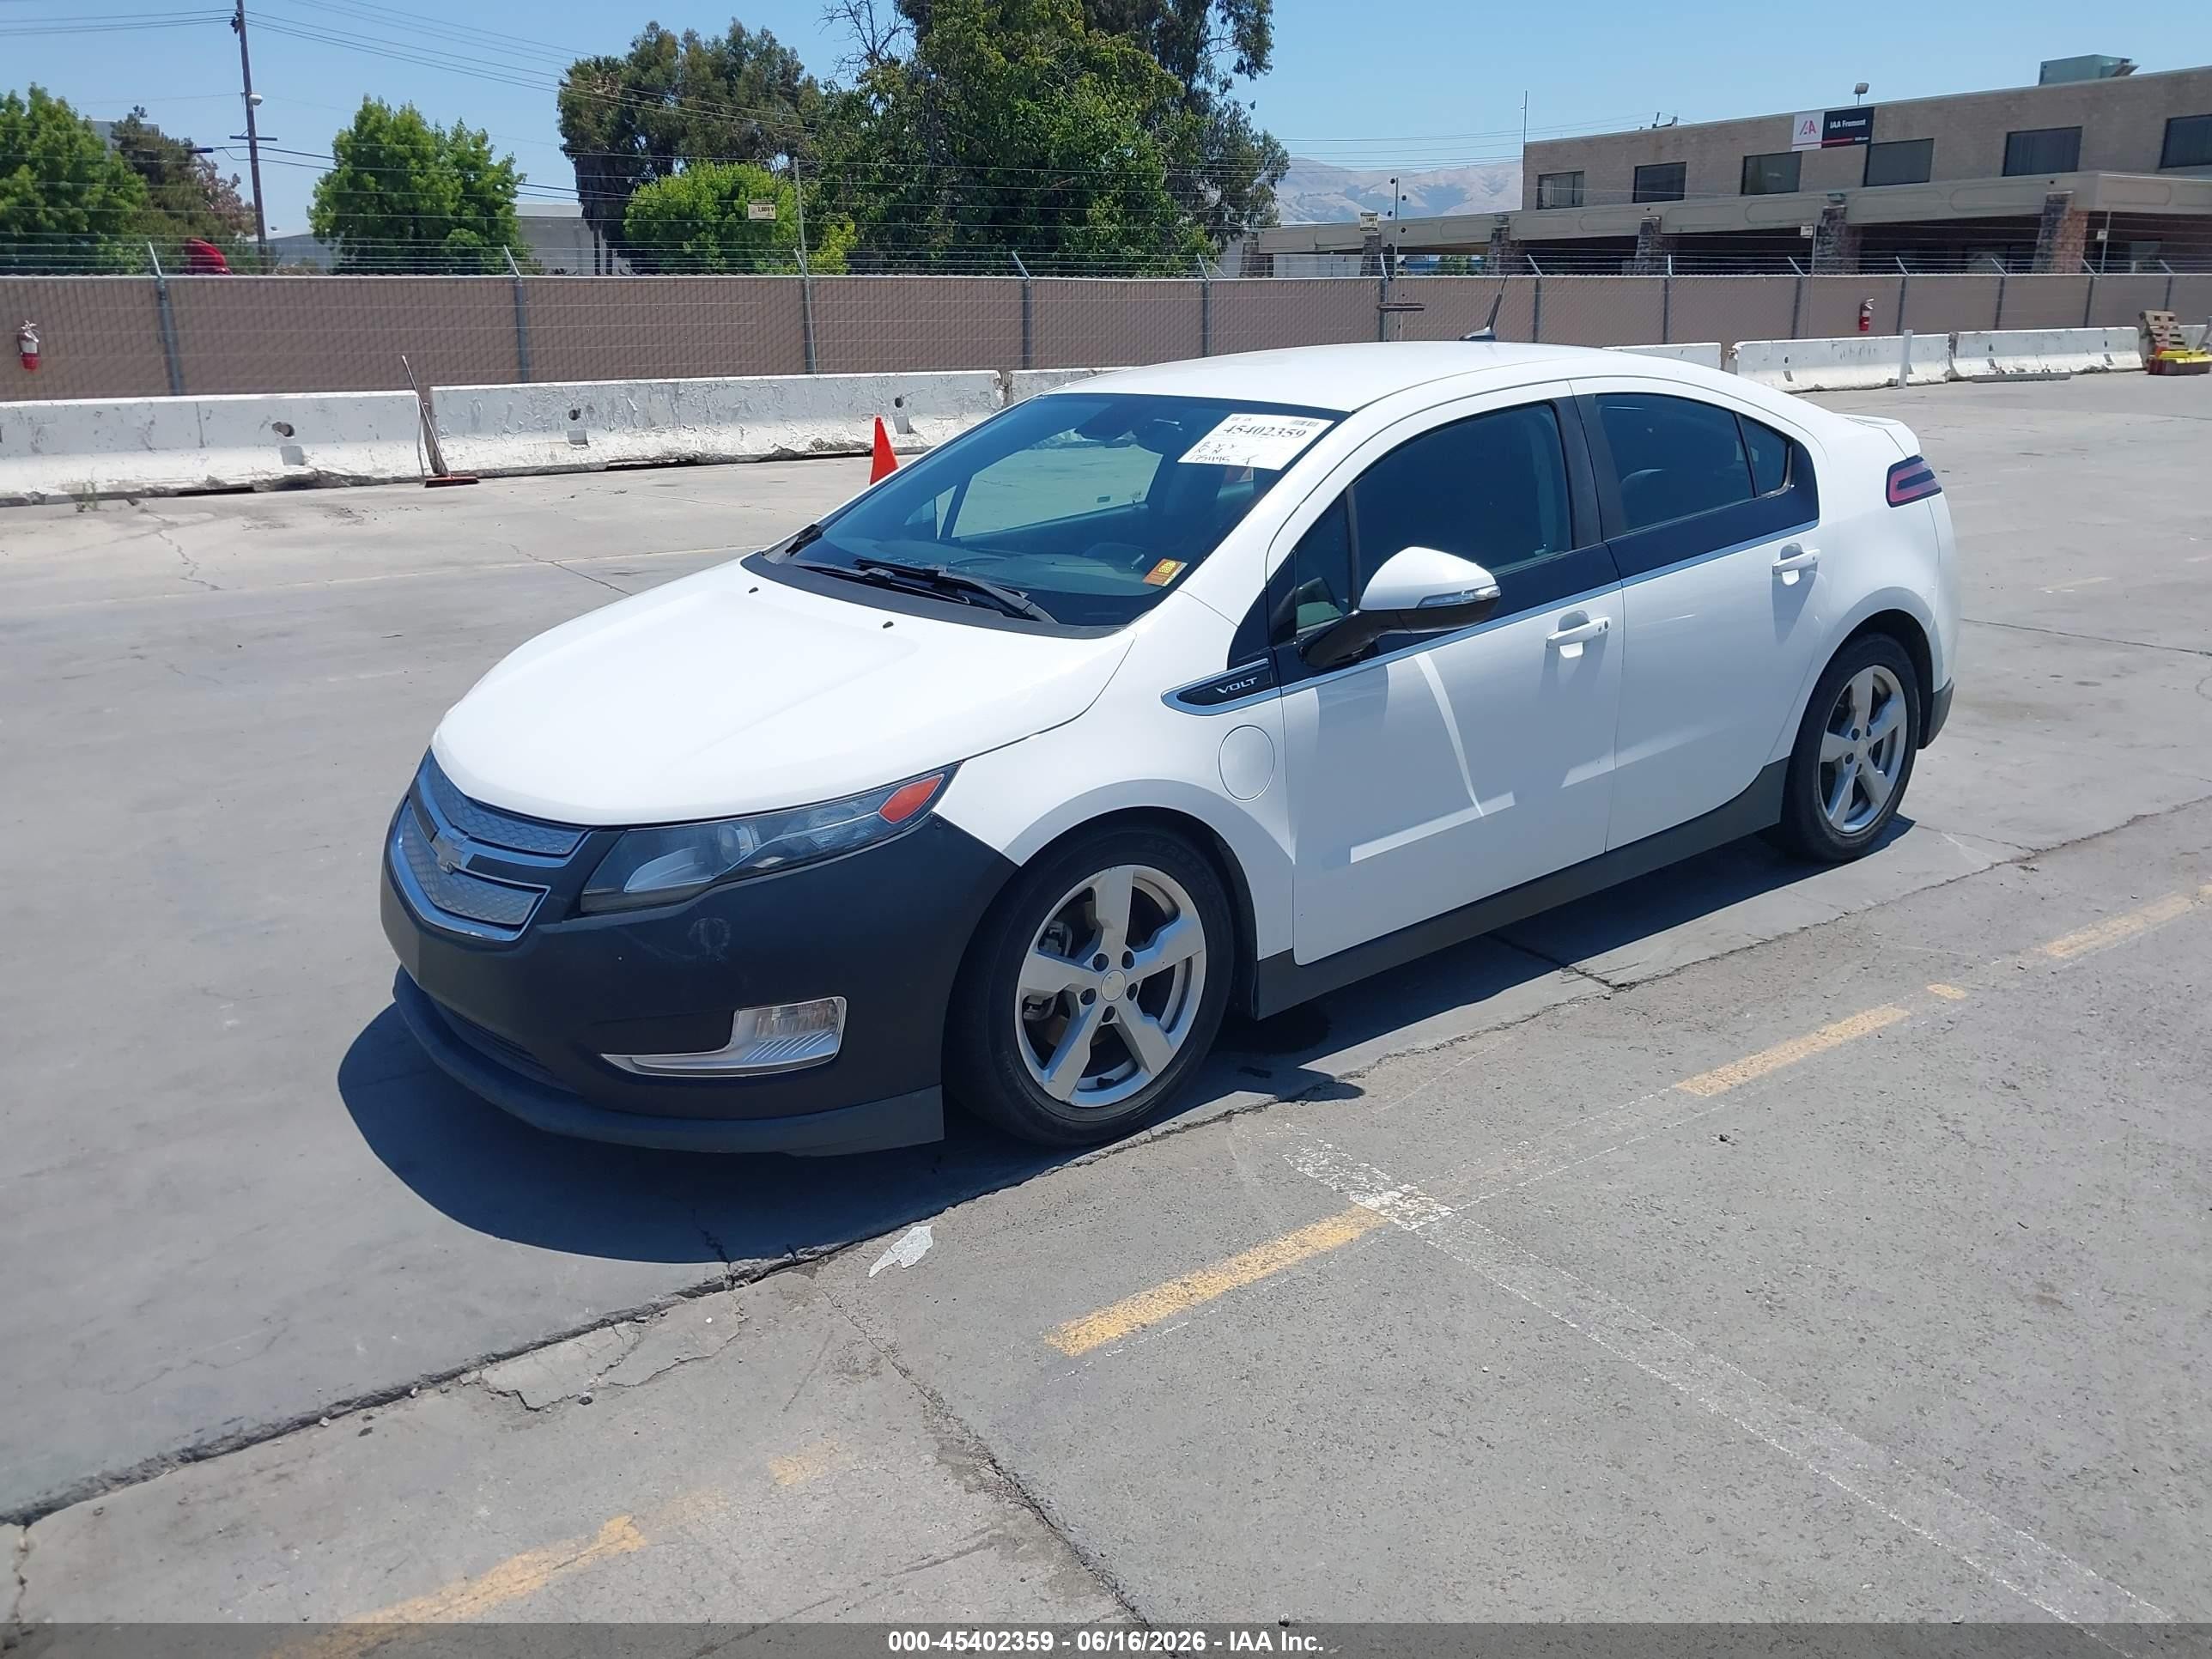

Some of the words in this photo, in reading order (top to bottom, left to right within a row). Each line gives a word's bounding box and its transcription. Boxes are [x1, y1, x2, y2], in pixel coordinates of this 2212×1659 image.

[1830, 120, 1841, 129] IAA
[1224, 424, 1306, 439] 45402359
[1216, 677, 1257, 694] VOLT
